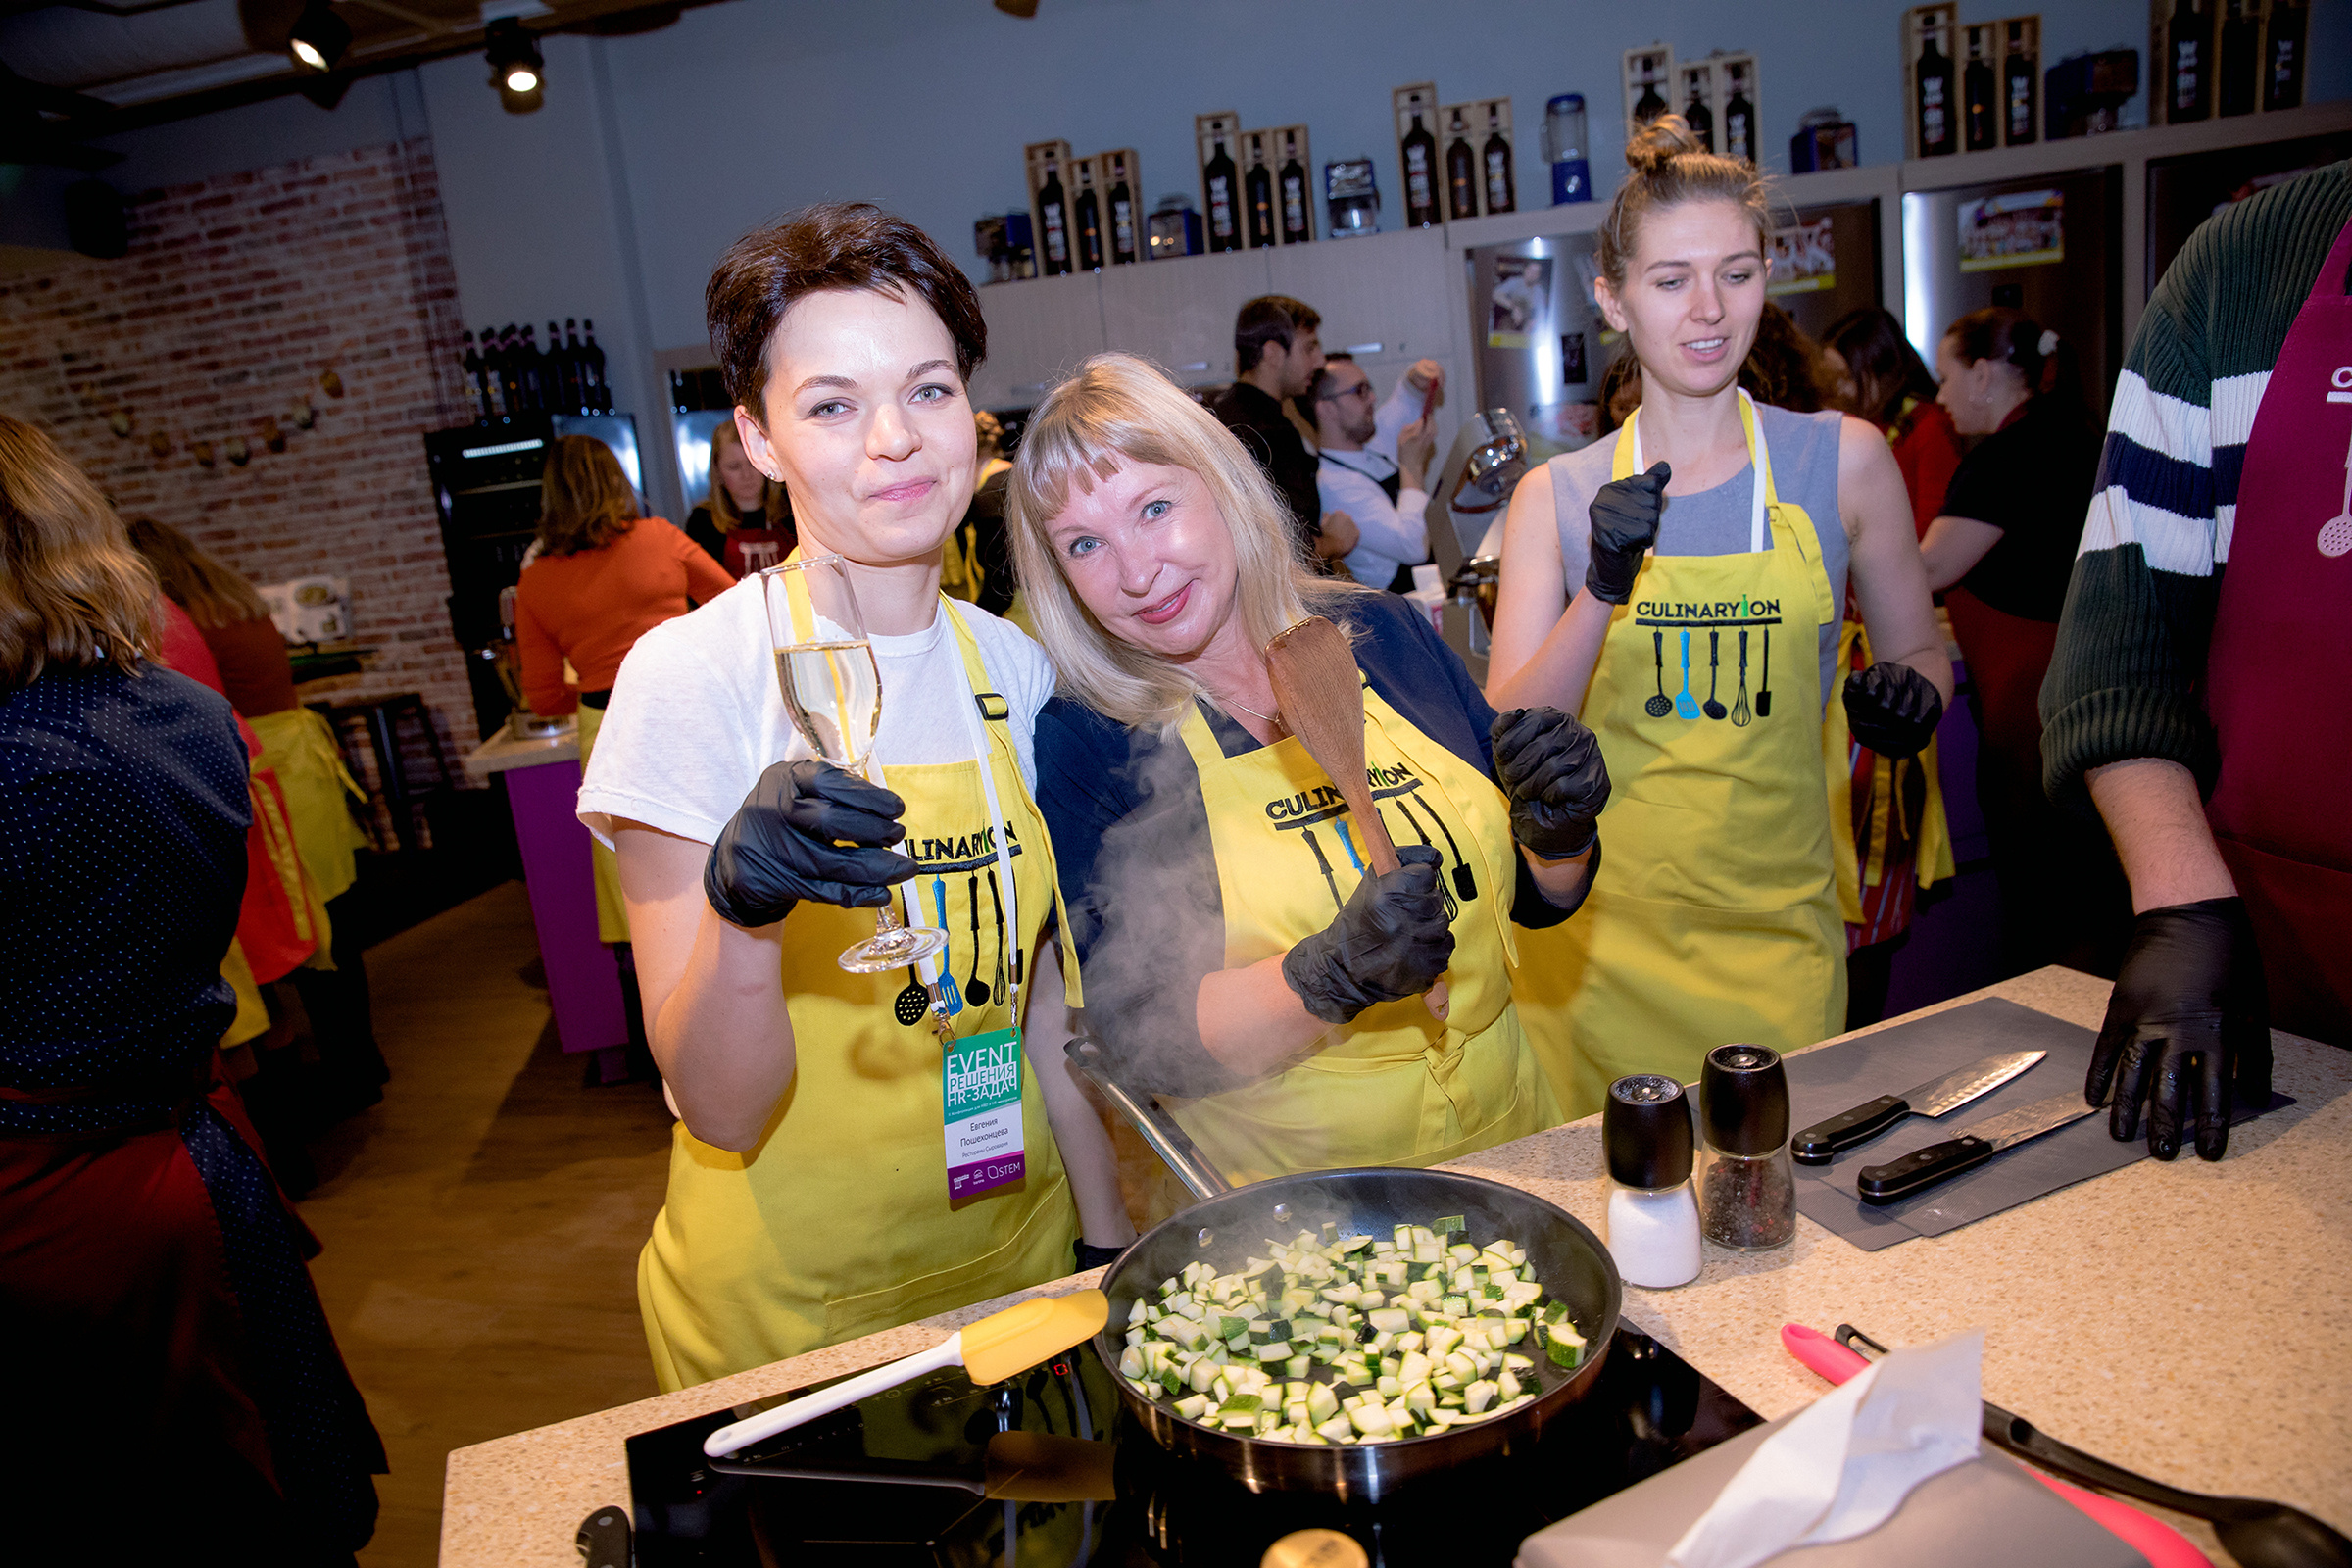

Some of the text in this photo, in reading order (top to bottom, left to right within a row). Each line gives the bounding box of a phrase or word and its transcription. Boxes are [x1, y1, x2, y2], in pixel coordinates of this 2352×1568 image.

[1265, 761, 1415, 820] CULINRYION
[947, 1041, 1017, 1076] EVENT
[948, 1077, 1017, 1107] HR-ЗАДАЧ
[949, 1063, 1015, 1092] РЕШЕНИЯ
[960, 1127, 1008, 1147] Пошехонцева
[970, 1118, 998, 1131] Евгения
[961, 1148, 985, 1158] Рестораны
